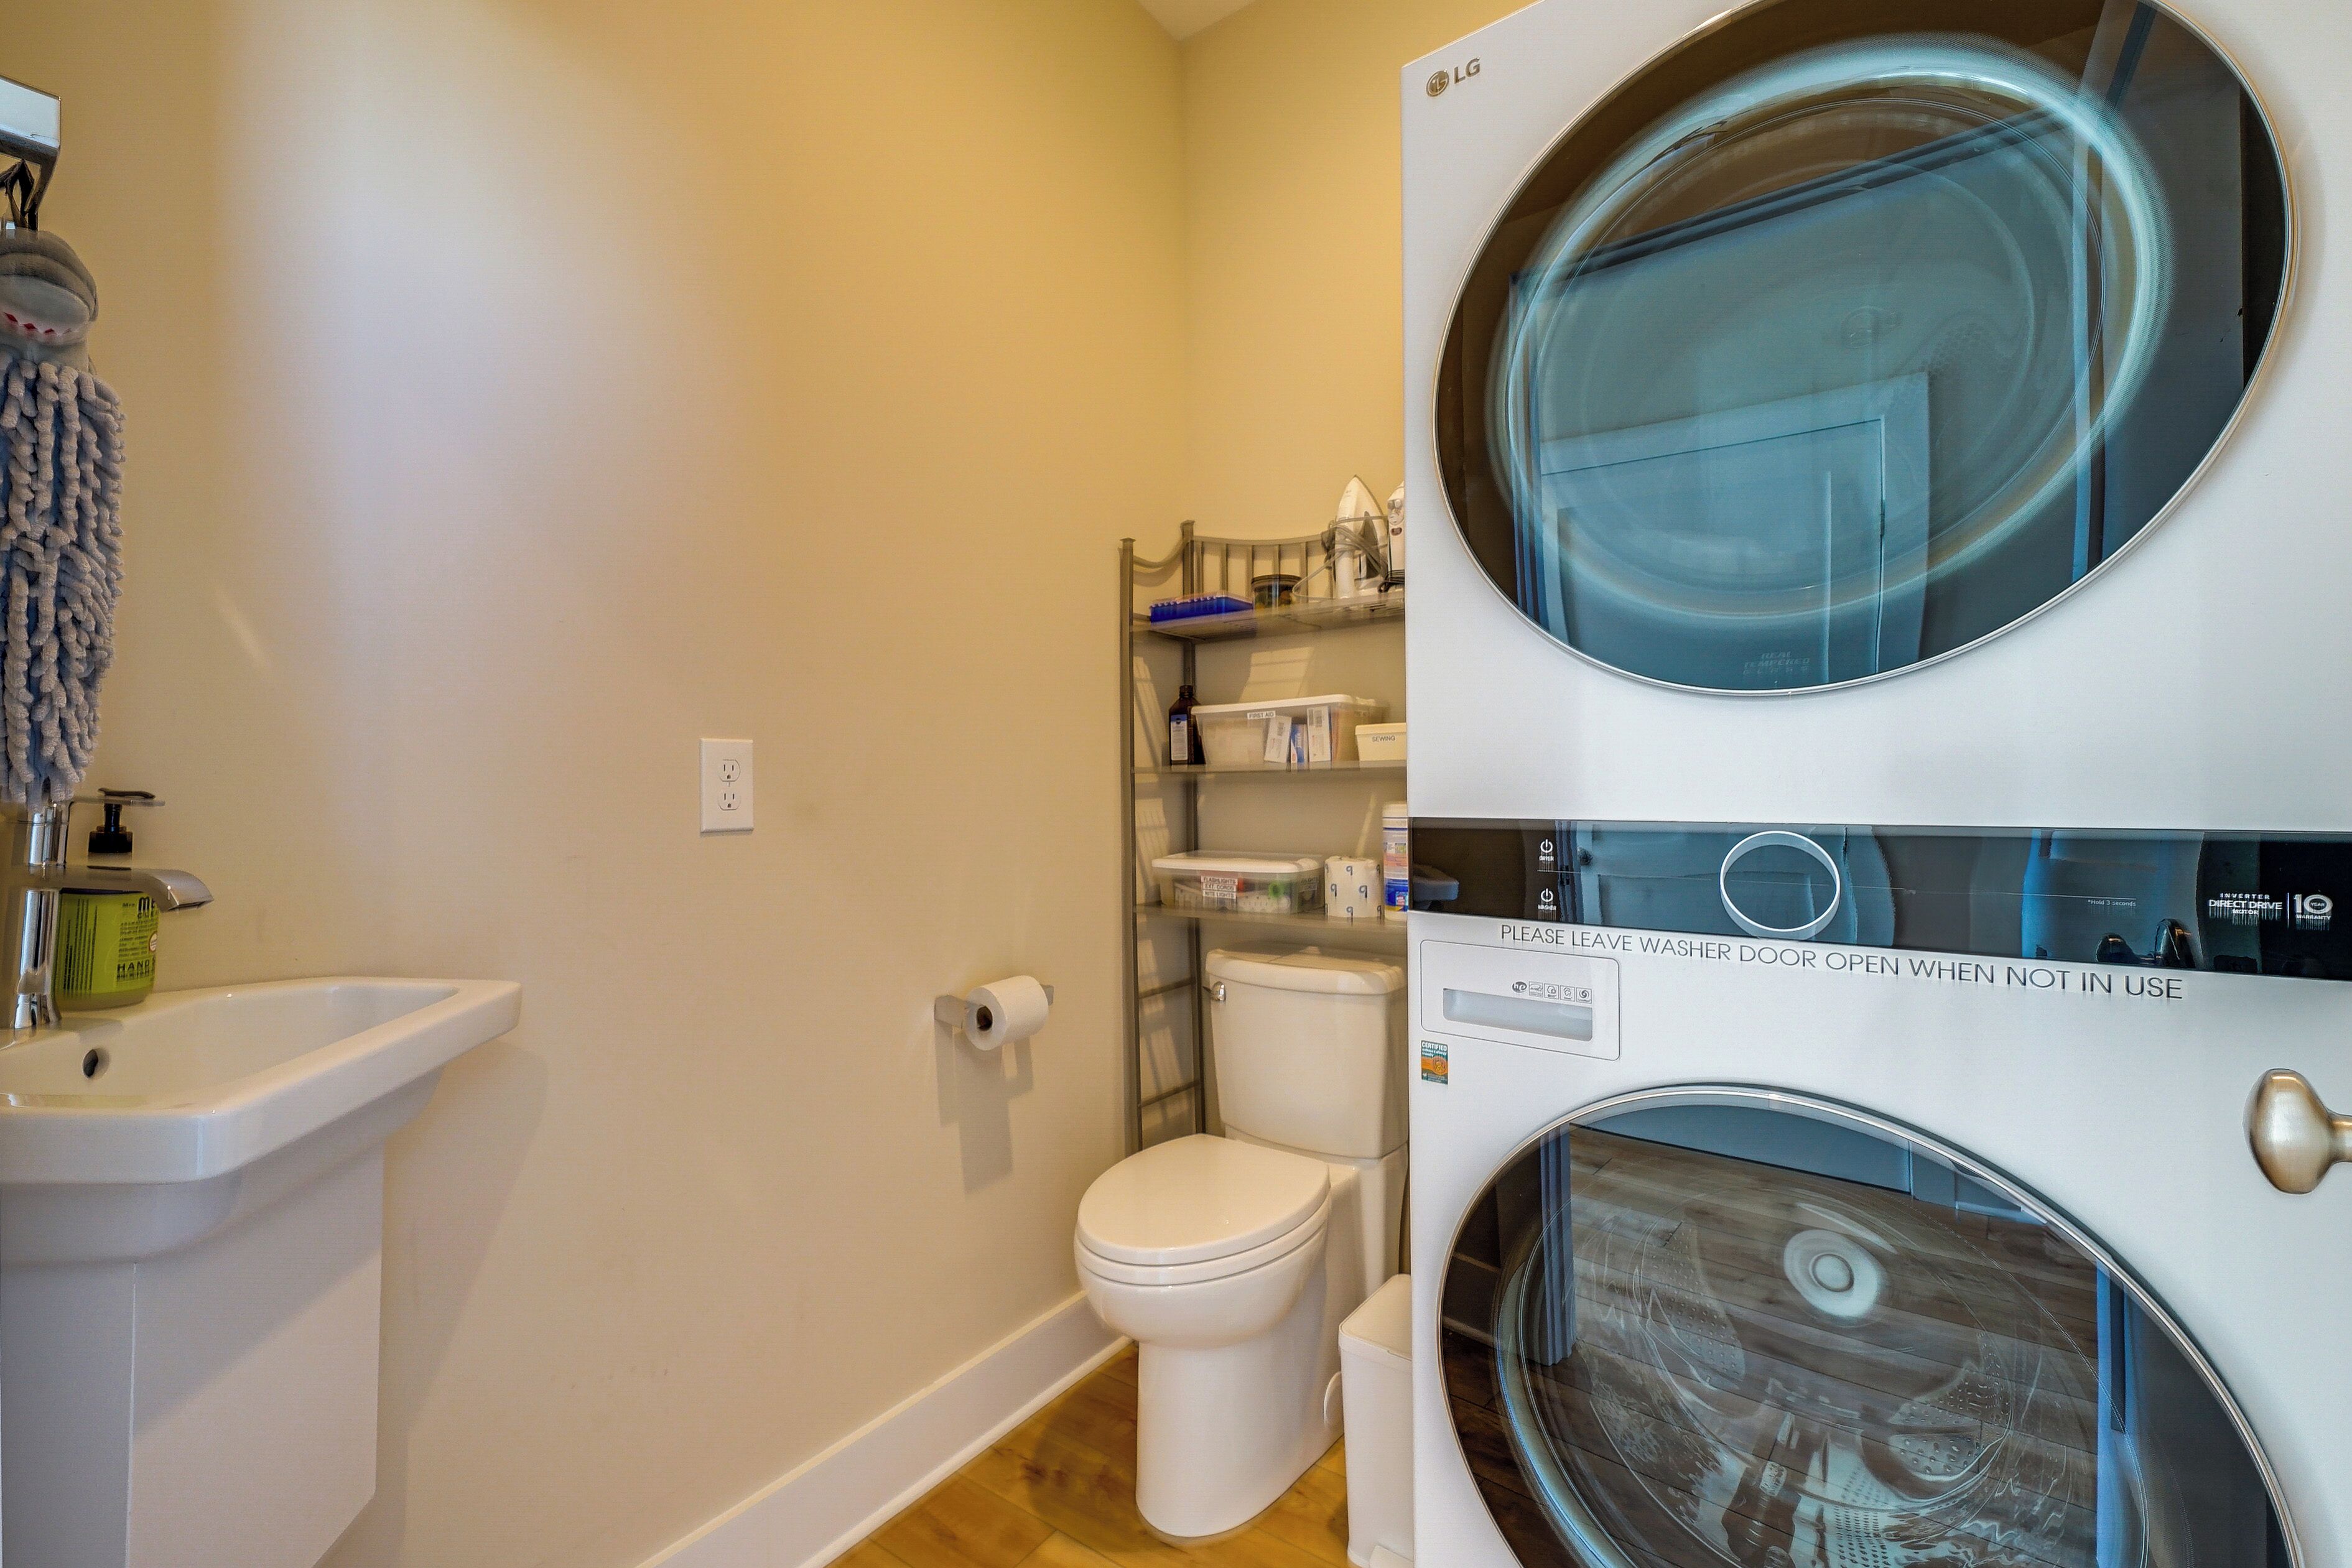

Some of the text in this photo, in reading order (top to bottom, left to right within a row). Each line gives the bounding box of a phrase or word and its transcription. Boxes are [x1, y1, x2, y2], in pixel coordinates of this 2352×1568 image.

[1454, 57, 1480, 84] LG
[2209, 899, 2283, 910] DIRECT DRIVE
[2294, 893, 2333, 914] 10
[1501, 924, 2183, 999] PLEASE LEAVE WASHER DOOR OPEN WHEN NOT IN USE
[1421, 1041, 1448, 1051] CERTIFIED
